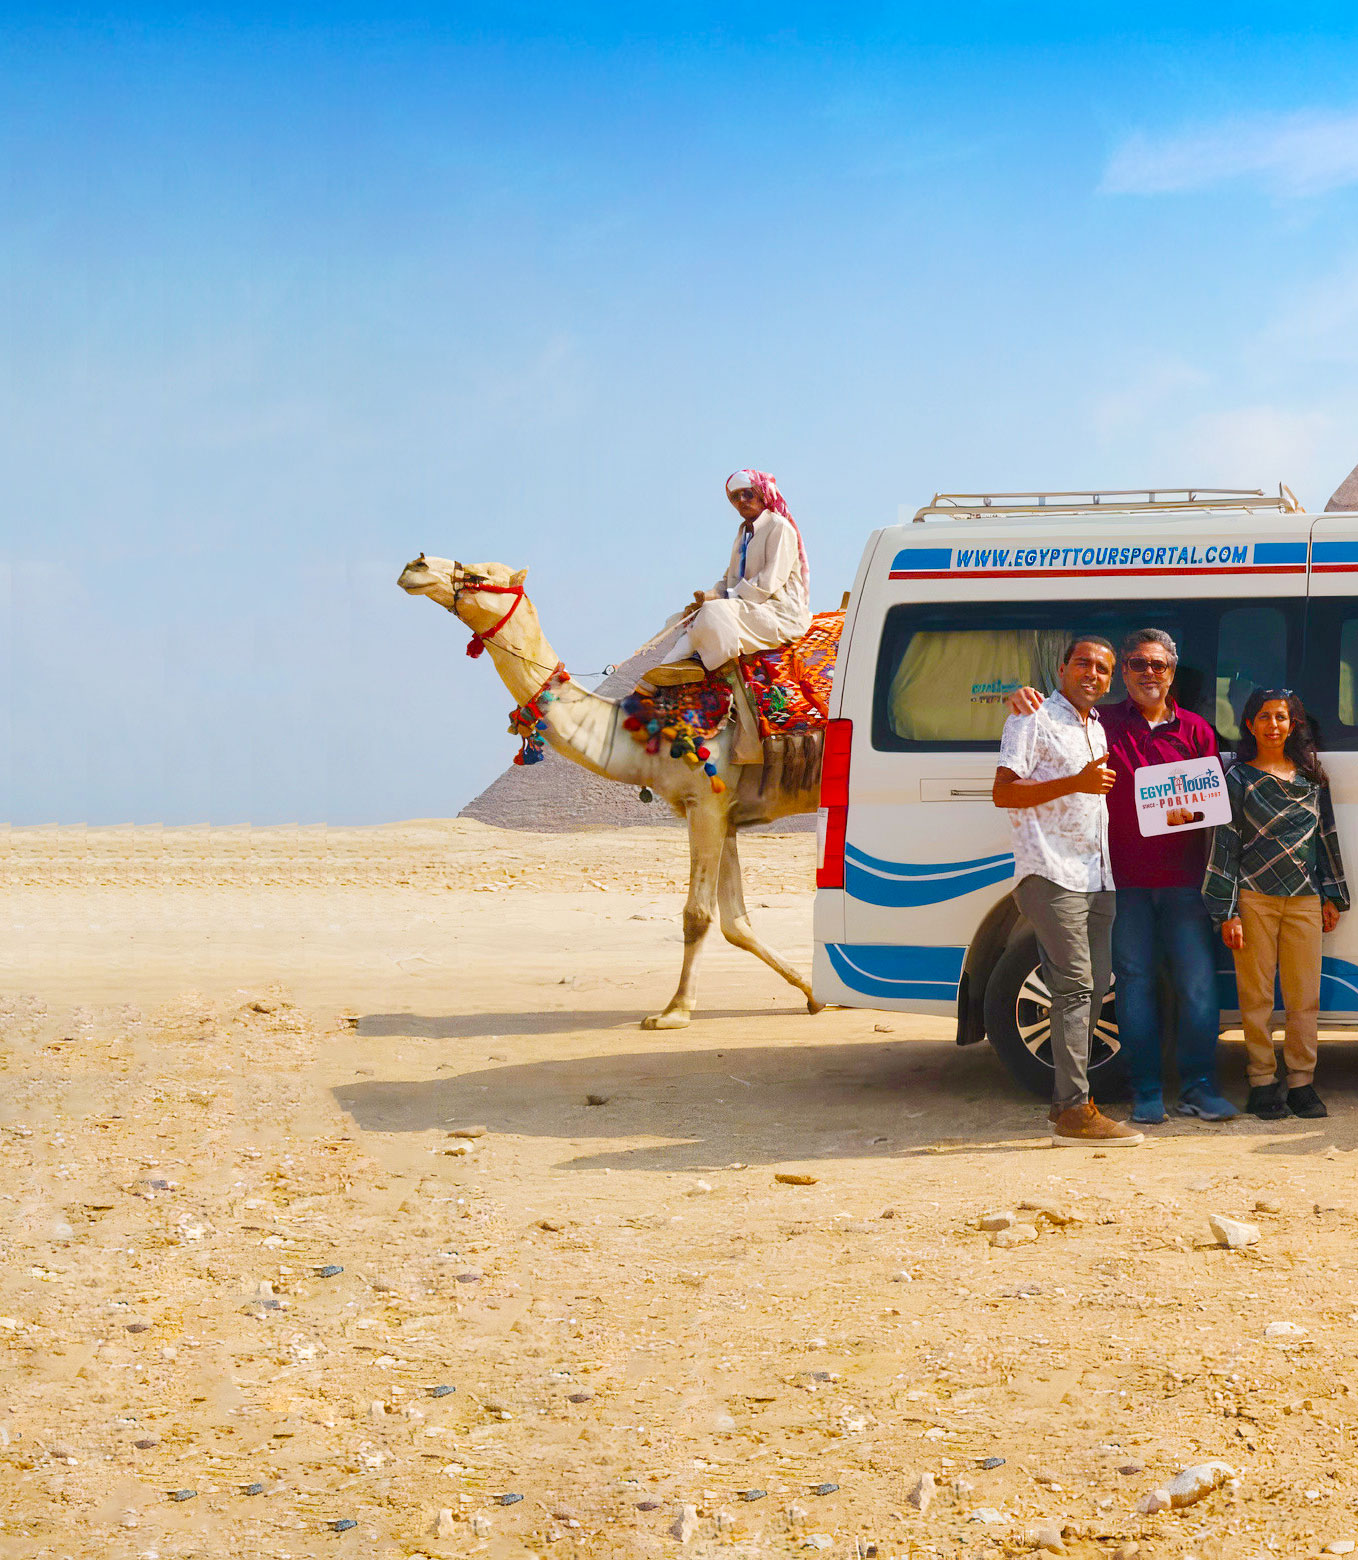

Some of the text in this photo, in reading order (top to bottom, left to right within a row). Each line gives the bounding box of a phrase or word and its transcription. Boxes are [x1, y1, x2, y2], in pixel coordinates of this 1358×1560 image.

[956, 545, 1248, 568] WWW.EGYPTTOURSPORTAL.COM
[1140, 774, 1220, 800] EGYPT TOURS
[1159, 792, 1206, 808] PORTAL
